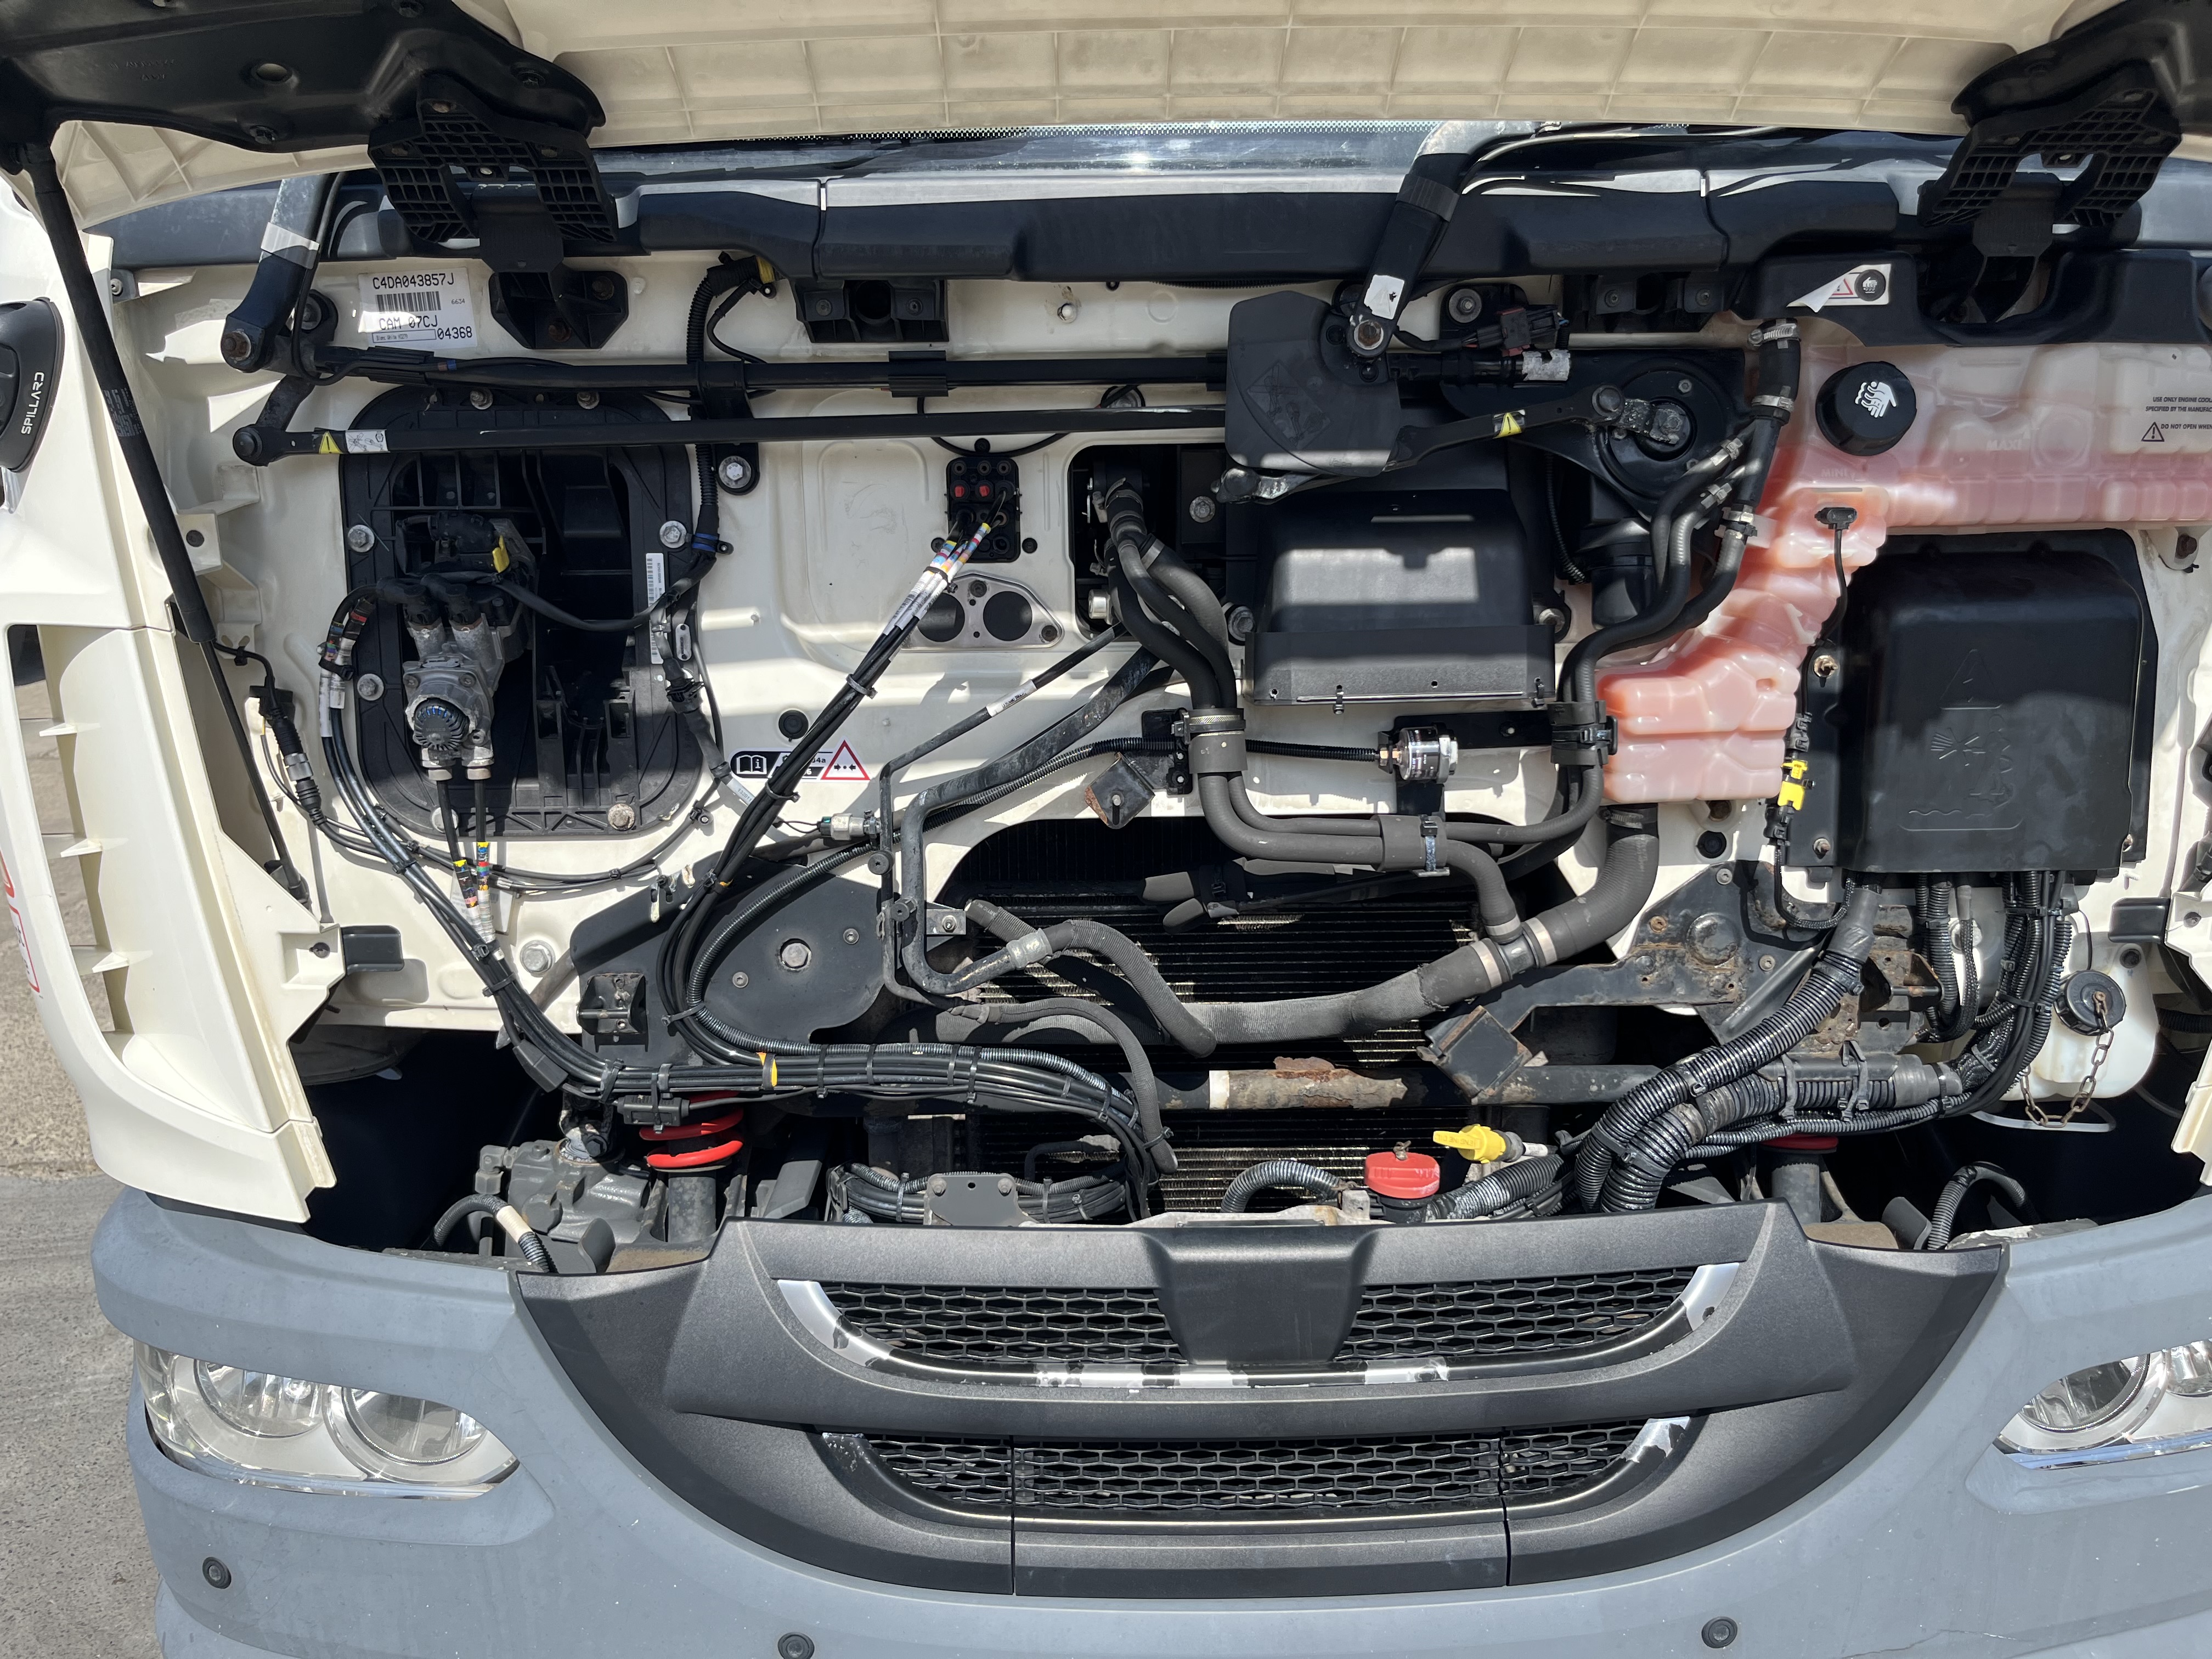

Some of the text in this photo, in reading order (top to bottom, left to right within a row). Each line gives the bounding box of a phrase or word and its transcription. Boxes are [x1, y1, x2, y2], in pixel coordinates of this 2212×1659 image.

[373, 273, 454, 289] C4DA043857J
[379, 315, 438, 330] CAM 07CJ
[437, 326, 472, 340] 04368
[21, 372, 45, 435] SPILLARD
[1986, 439, 2023, 451] MAXI
[1821, 467, 1848, 478] MINI
